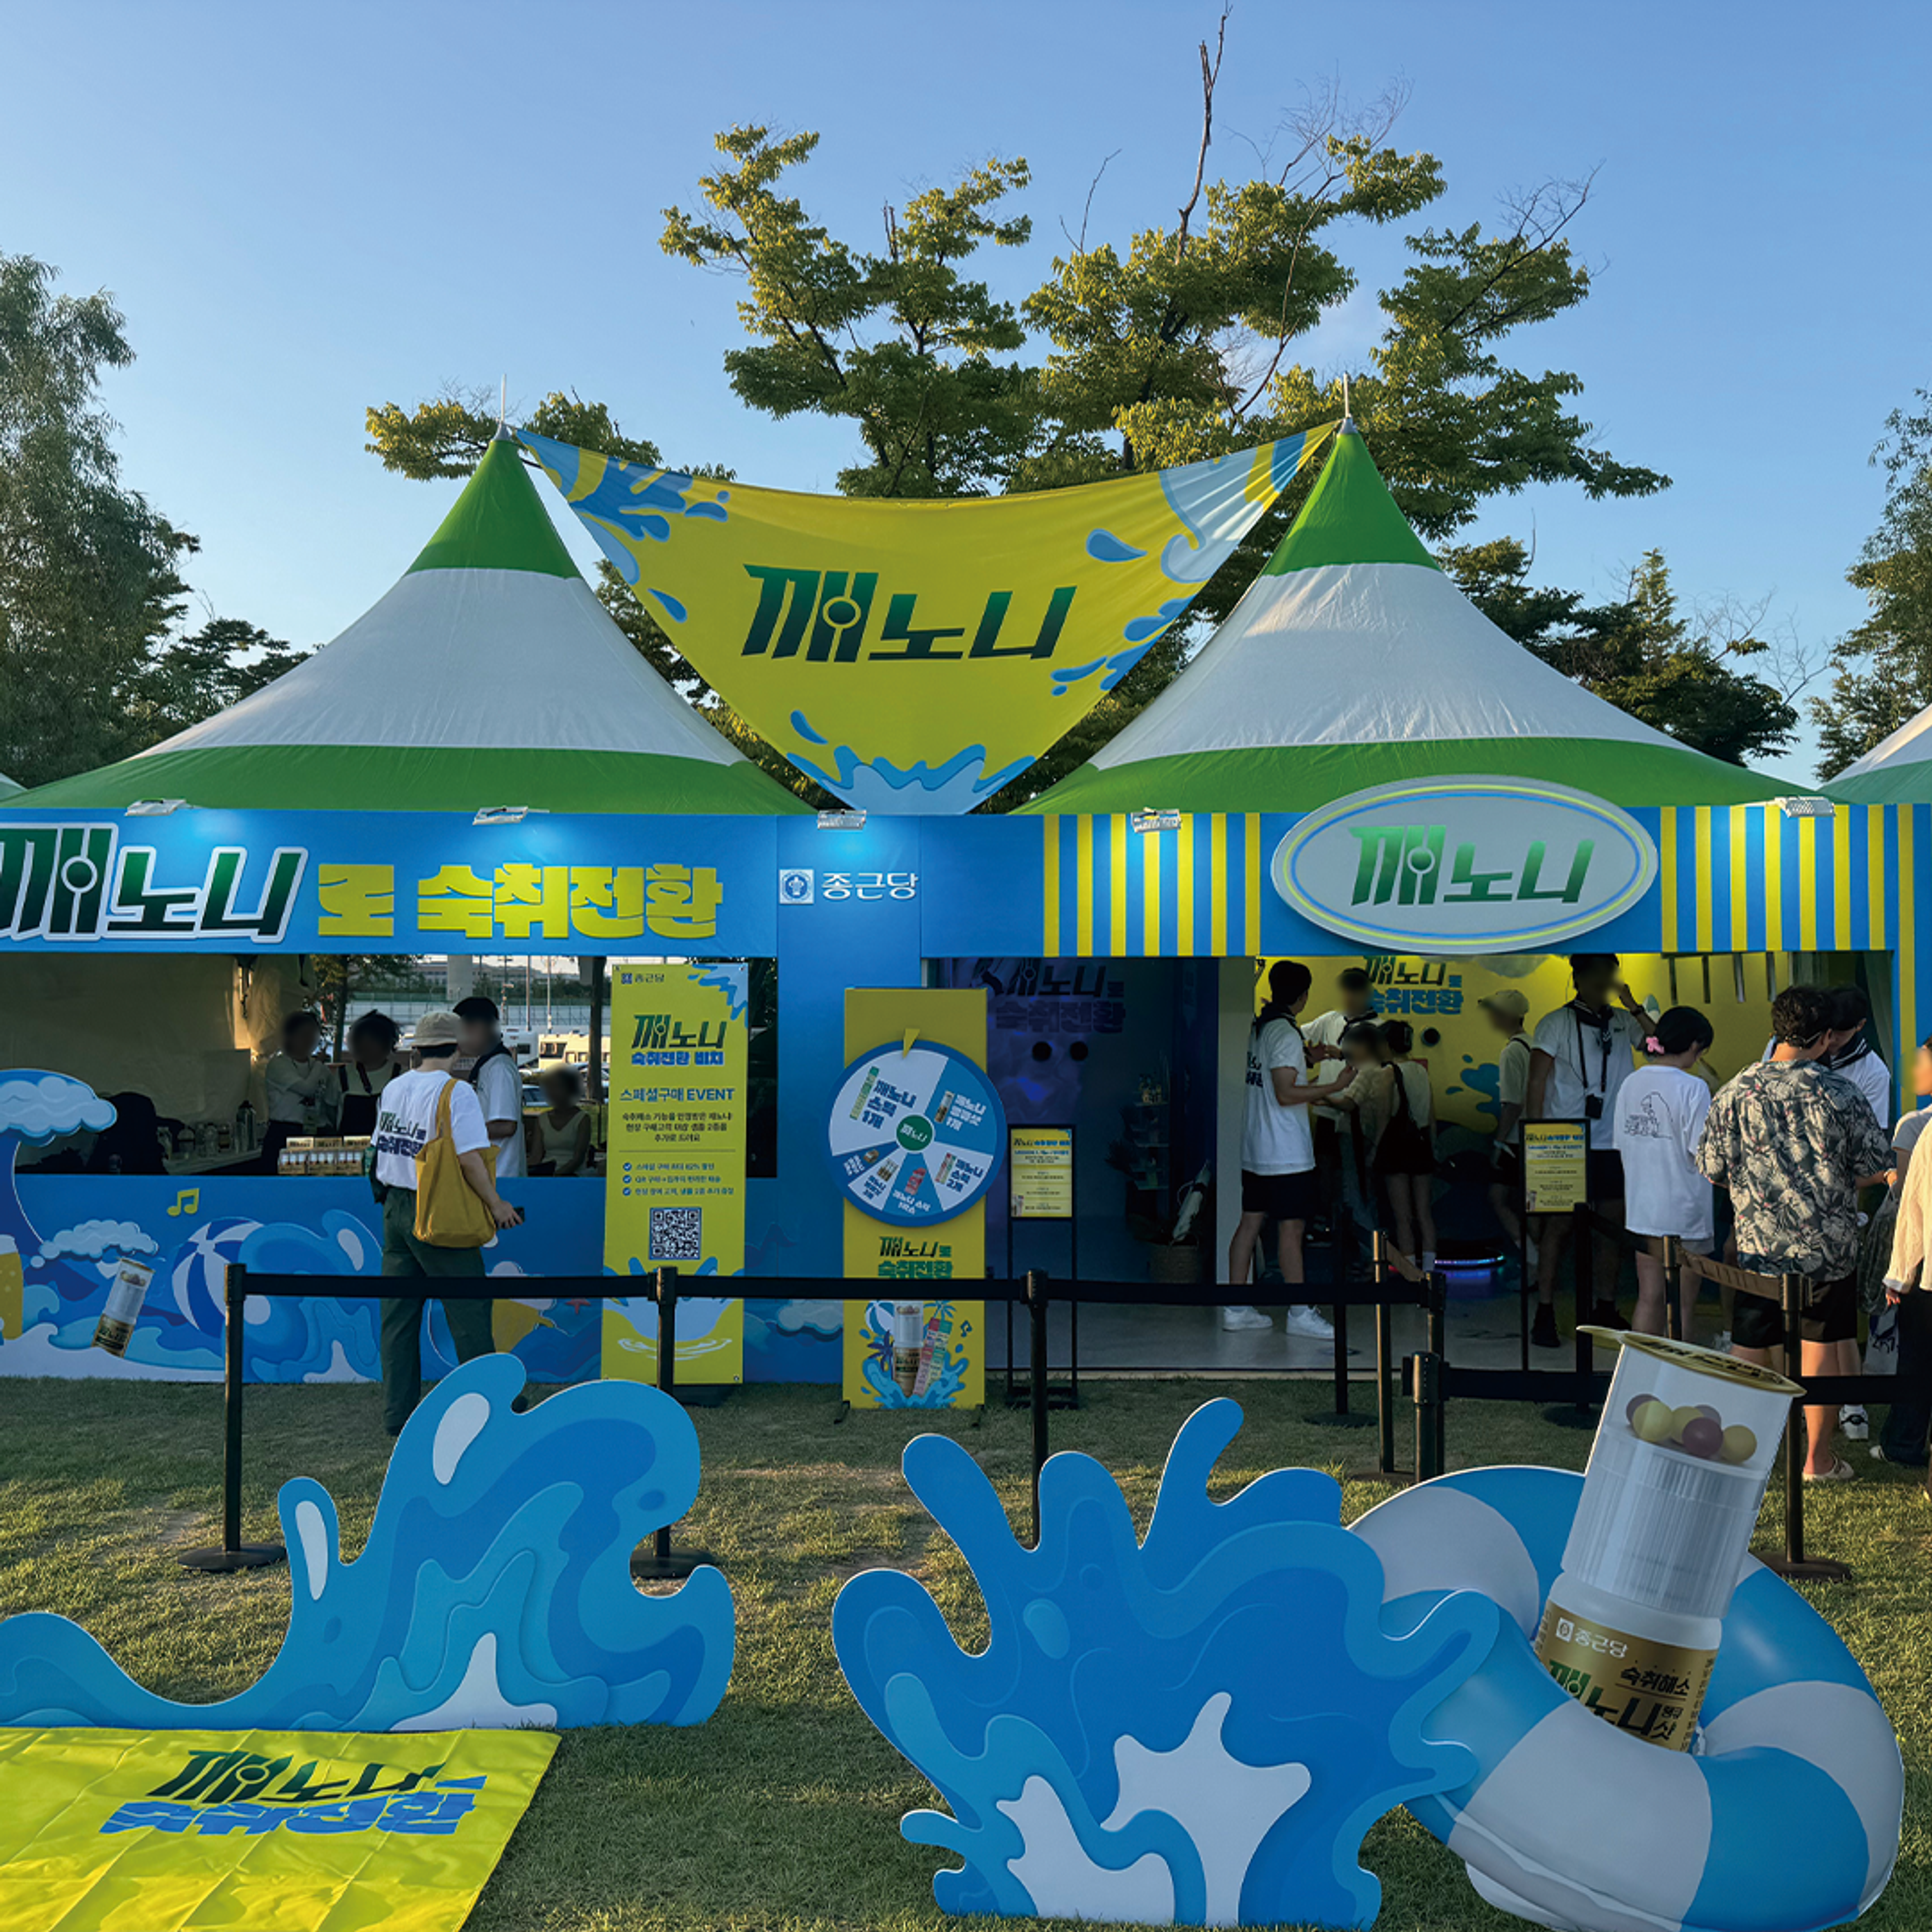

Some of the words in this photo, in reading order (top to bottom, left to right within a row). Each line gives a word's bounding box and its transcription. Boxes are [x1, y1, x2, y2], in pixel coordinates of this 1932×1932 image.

[741, 563, 1078, 663] 깨노니
[1348, 824, 1595, 906] 깨노니
[418, 863, 723, 939] 숙취전환
[822, 872, 919, 900] 종근당
[635, 974, 665, 983] 종근당
[631, 1014, 727, 1049] 깨노니
[687, 1088, 735, 1100] EVENT
[873, 1080, 917, 1108] 깨노니
[861, 1111, 885, 1130] 1개
[1574, 1627, 1629, 1658] 종근당
[1621, 1667, 1689, 1697] 숙취해소
